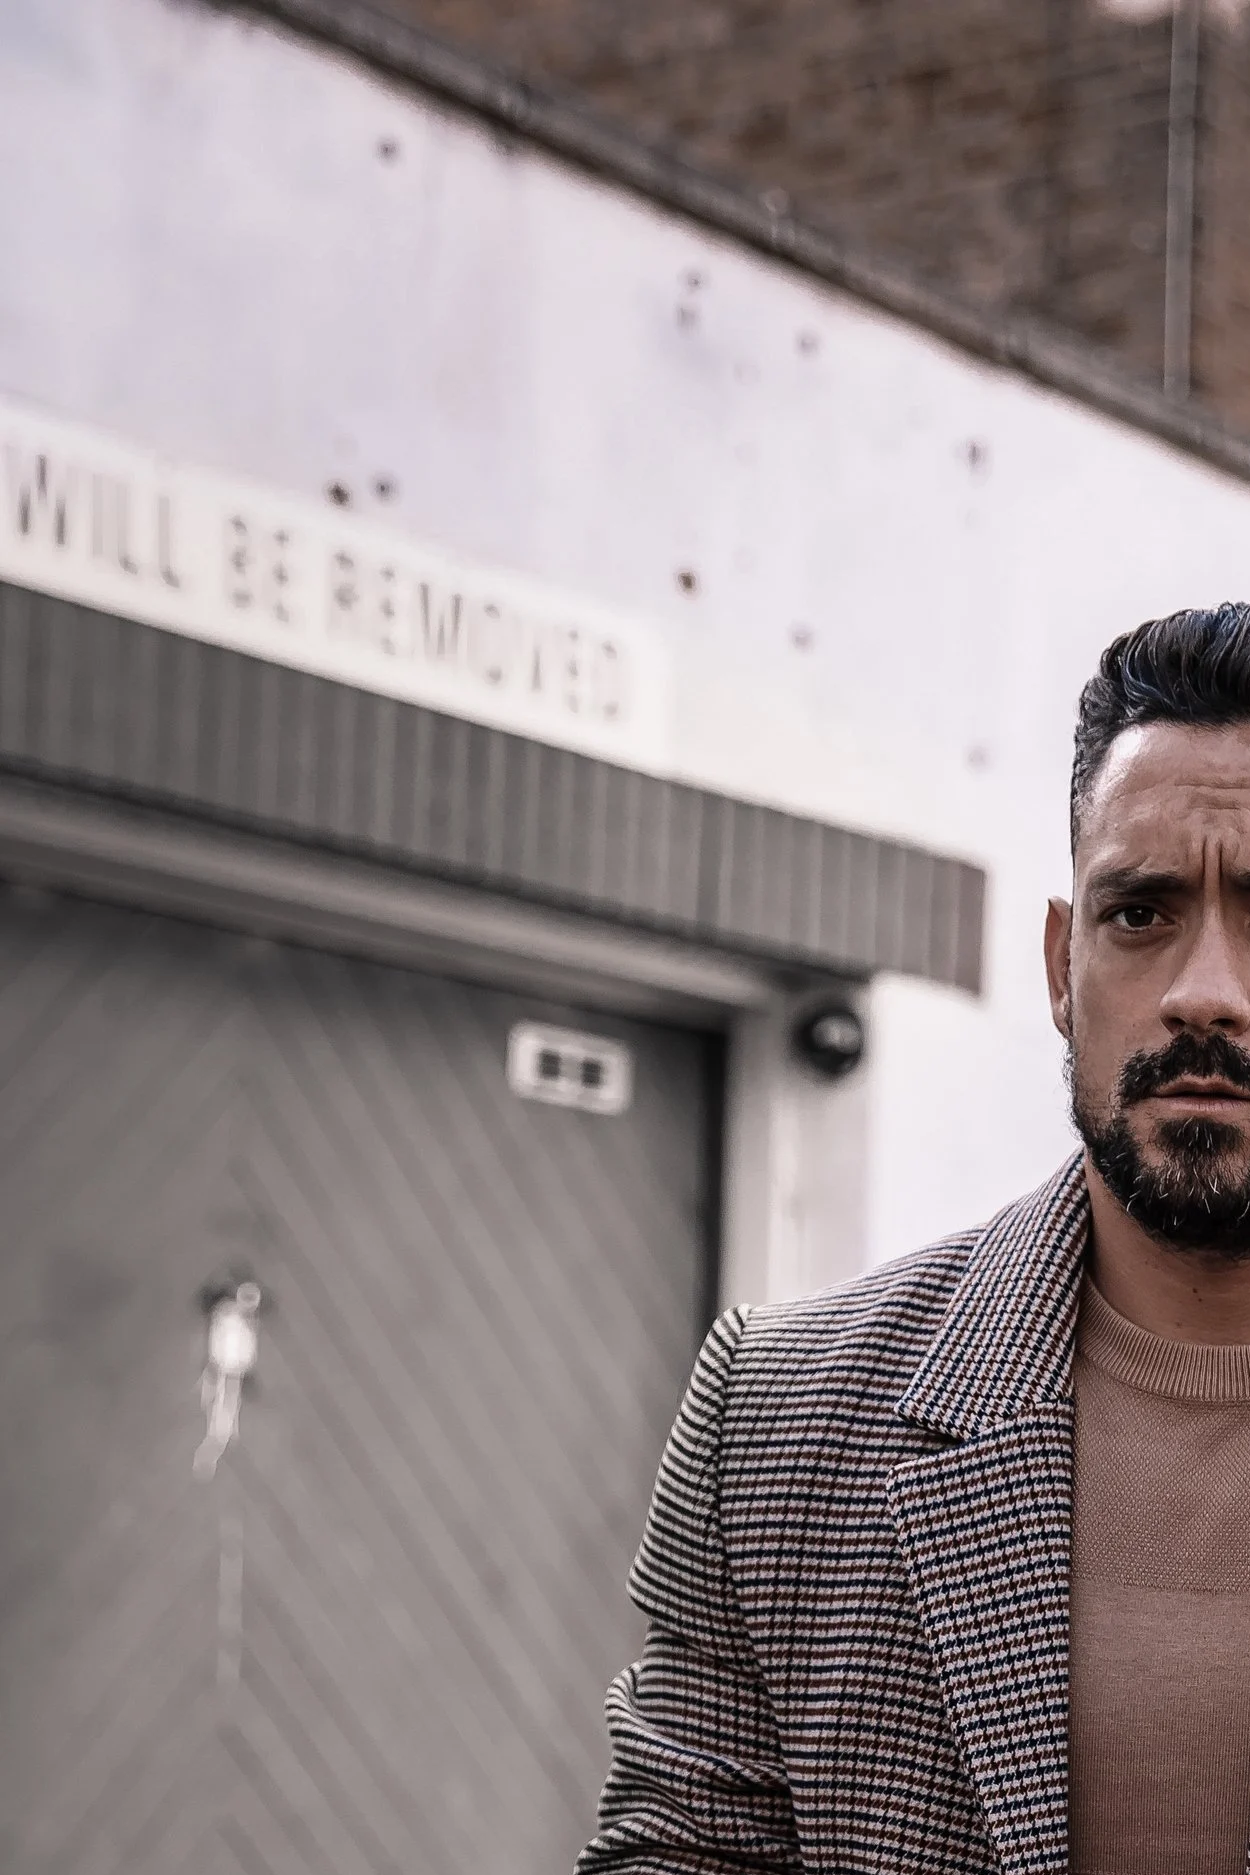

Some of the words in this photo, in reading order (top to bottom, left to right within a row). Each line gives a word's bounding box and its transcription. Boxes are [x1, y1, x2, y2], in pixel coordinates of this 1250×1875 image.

[4, 444, 180, 587] WILL
[225, 515, 292, 622] BE
[326, 548, 630, 720] REMOVED
